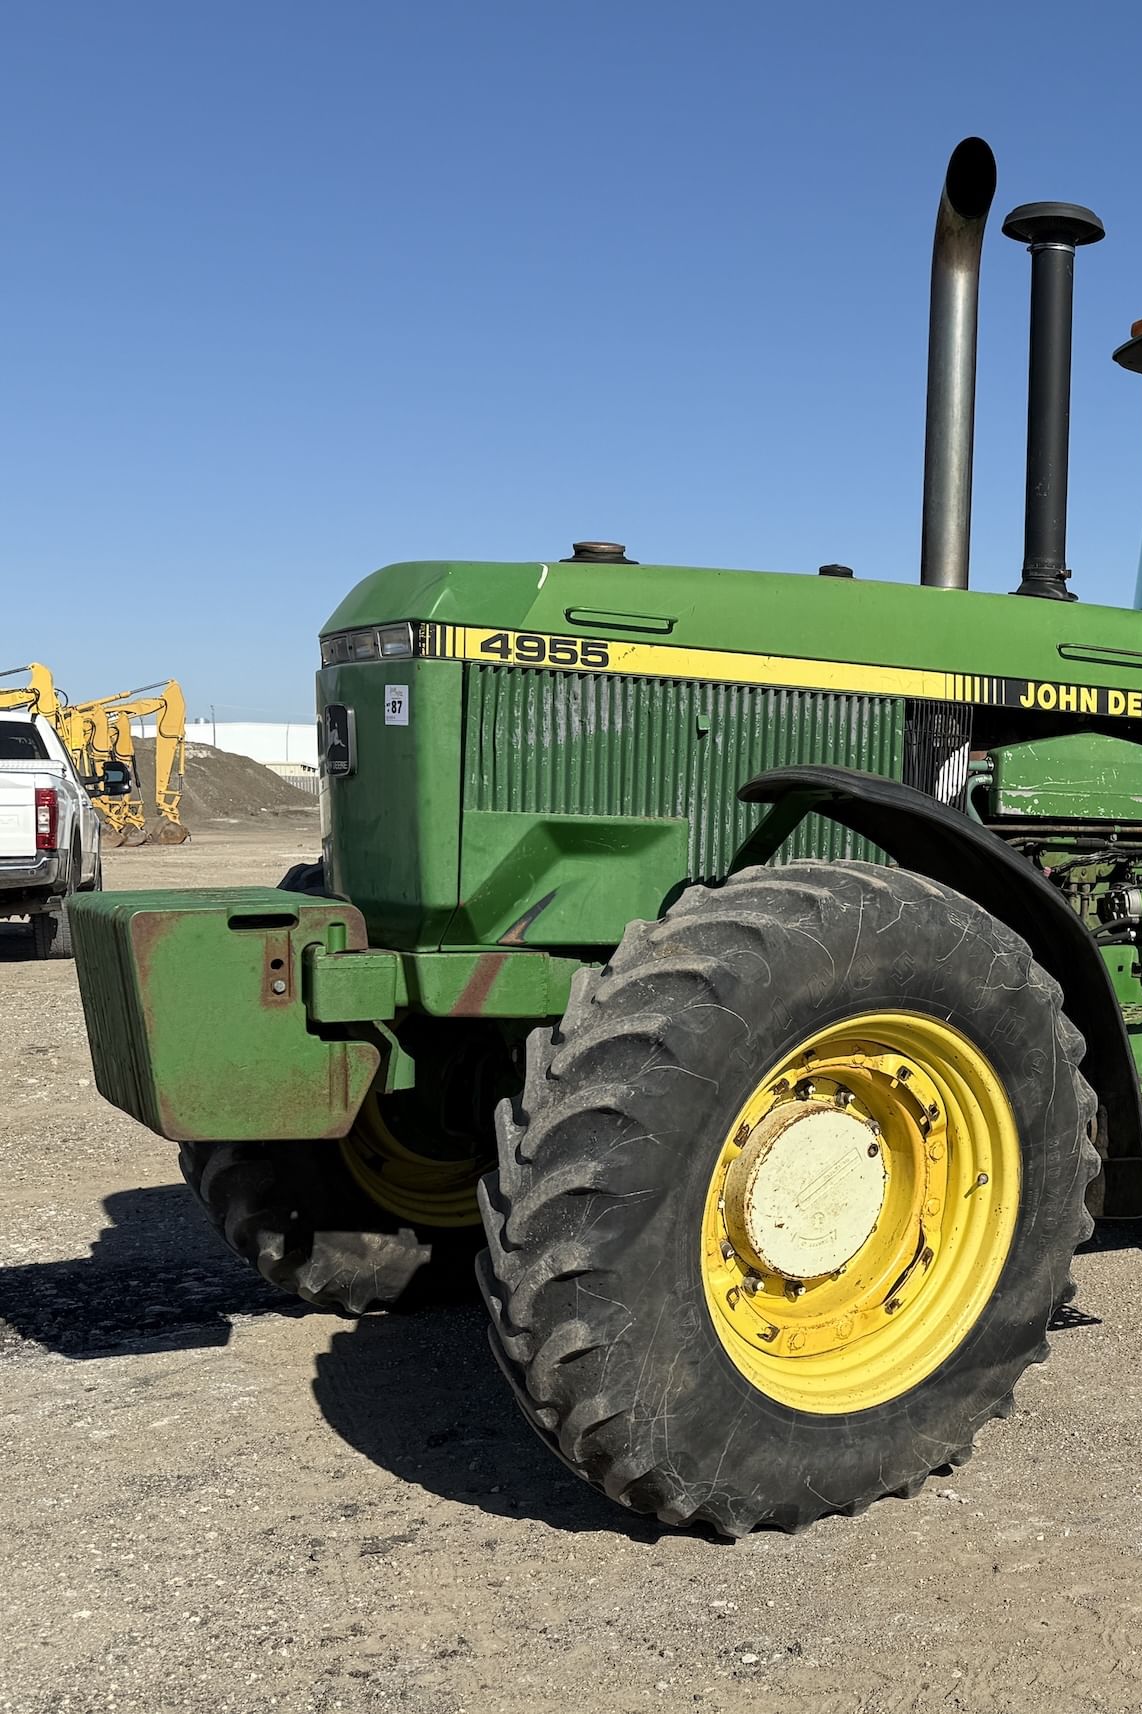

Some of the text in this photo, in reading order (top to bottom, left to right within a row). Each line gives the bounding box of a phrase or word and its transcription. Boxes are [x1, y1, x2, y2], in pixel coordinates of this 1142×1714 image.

[480, 633, 609, 668] 4955
[391, 700, 403, 714] 87
[1019, 682, 1098, 714] JOHN
